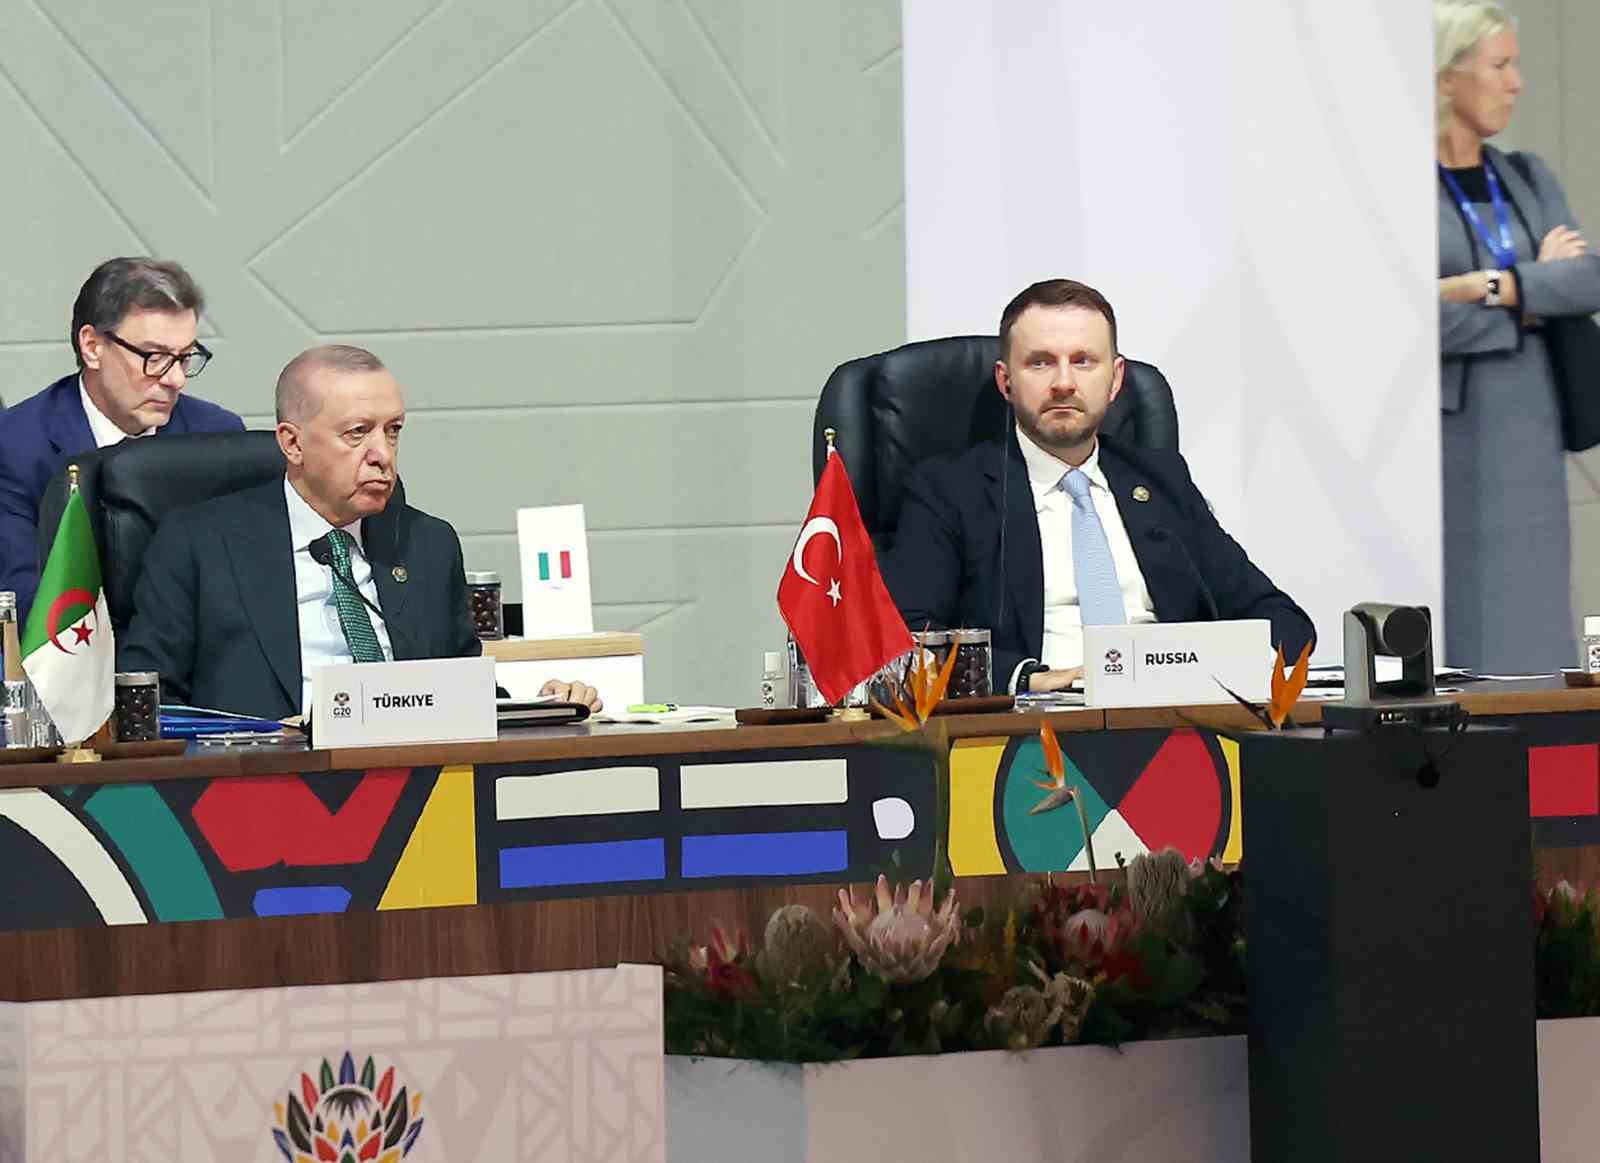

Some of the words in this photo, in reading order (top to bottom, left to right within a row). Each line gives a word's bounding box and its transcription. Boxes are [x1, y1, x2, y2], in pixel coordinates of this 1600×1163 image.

[1145, 652, 1199, 666] RUSSIA
[1104, 663, 1124, 673] G20
[372, 692, 434, 709] TÜRKIYE
[333, 706, 352, 717] G20
